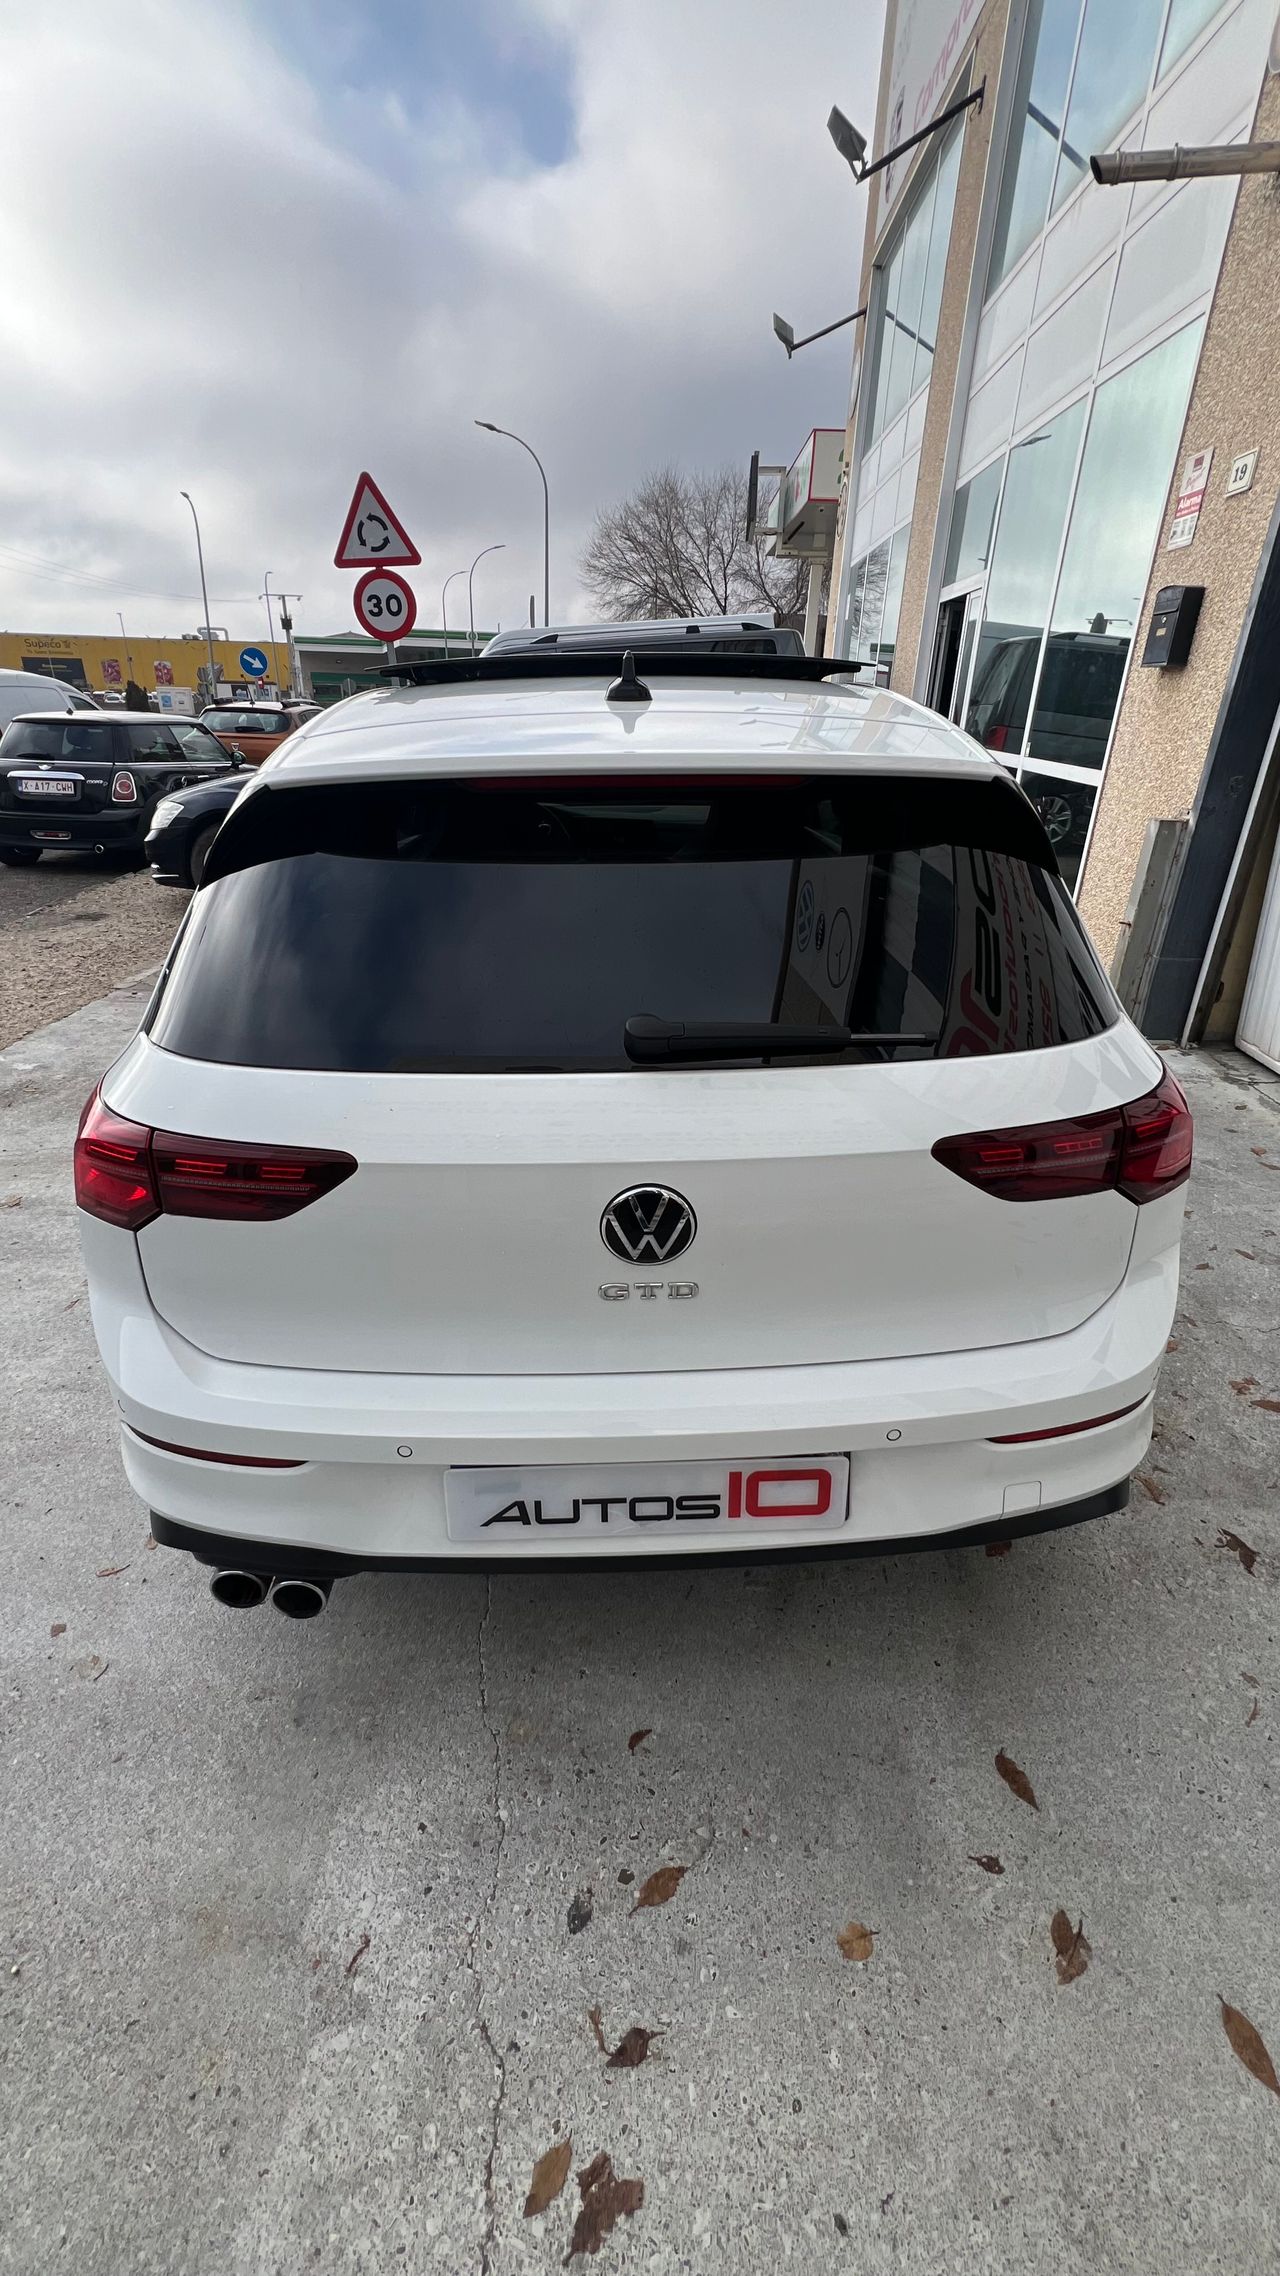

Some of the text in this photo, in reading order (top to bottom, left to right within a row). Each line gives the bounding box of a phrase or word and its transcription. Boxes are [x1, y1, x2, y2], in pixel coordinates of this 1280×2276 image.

[1232, 463, 1248, 483] 19
[1177, 494, 1202, 511] Alarma
[366, 594, 403, 617] 30
[23, 638, 62, 649] Supeco
[598, 1281, 700, 1301] GTD
